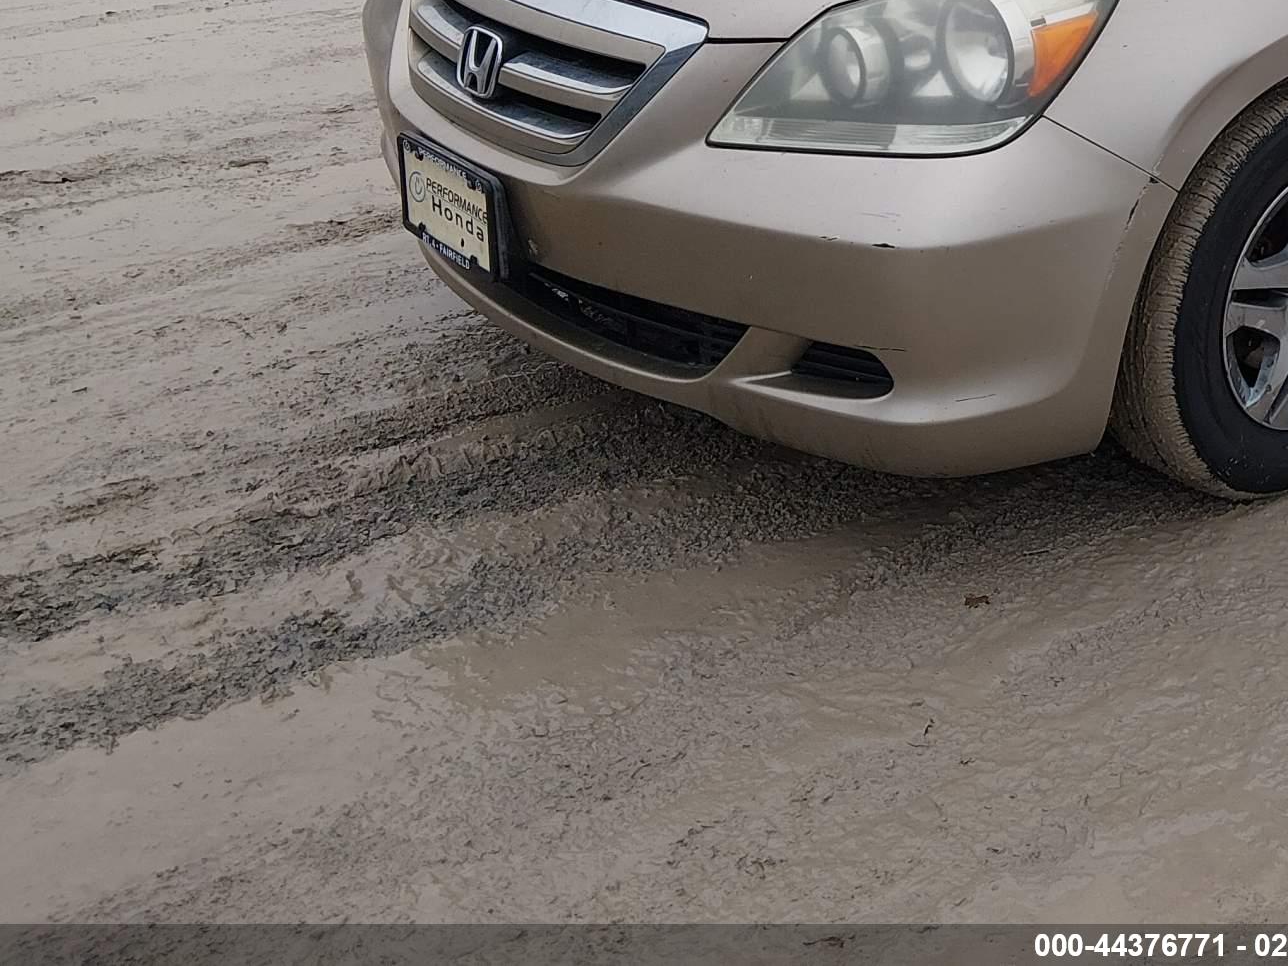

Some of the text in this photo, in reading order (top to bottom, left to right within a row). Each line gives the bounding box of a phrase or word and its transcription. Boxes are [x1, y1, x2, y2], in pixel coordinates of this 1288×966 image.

[426, 178, 489, 224] PERFORMANCE
[431, 195, 485, 243] Honda
[439, 243, 470, 270] FAIRFIELD
